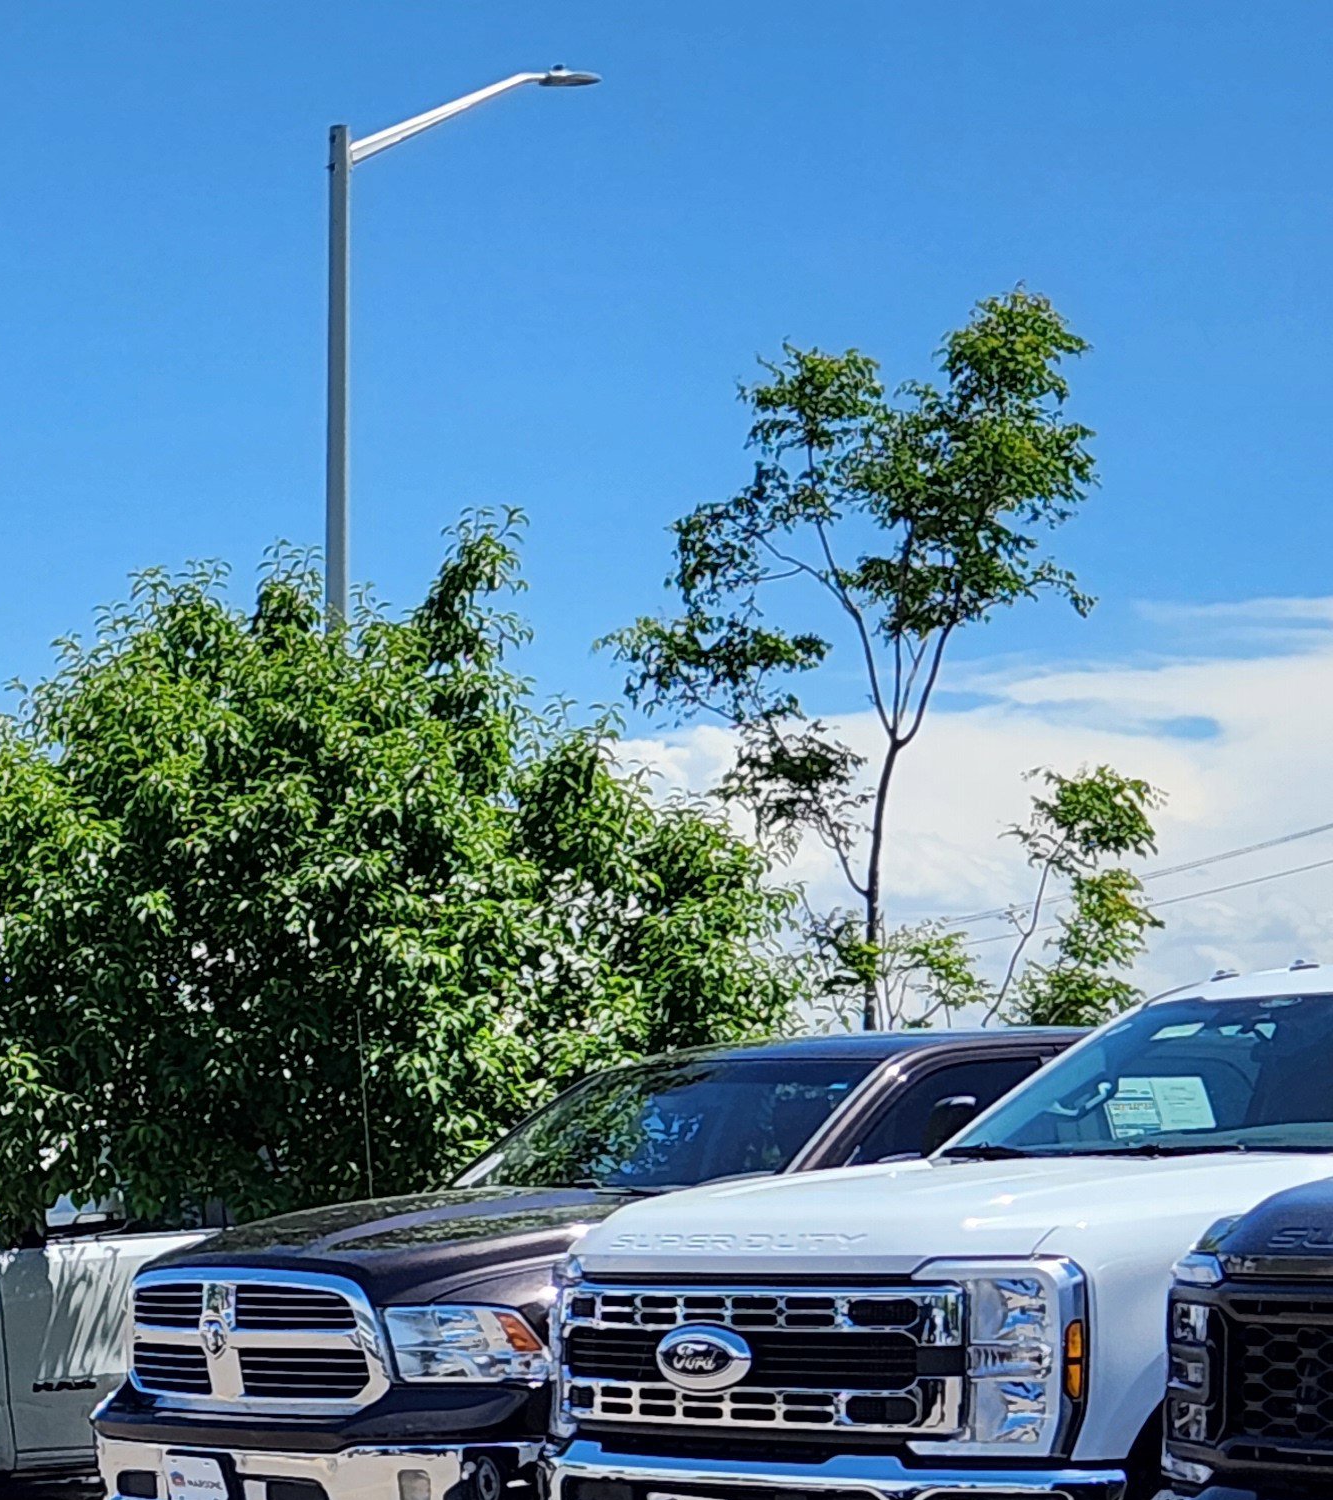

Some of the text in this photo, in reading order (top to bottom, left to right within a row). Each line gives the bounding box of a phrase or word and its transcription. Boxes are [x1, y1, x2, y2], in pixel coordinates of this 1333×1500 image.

[609, 1233, 868, 1251] SUPER DUTY
[672, 1343, 718, 1371] Ford
